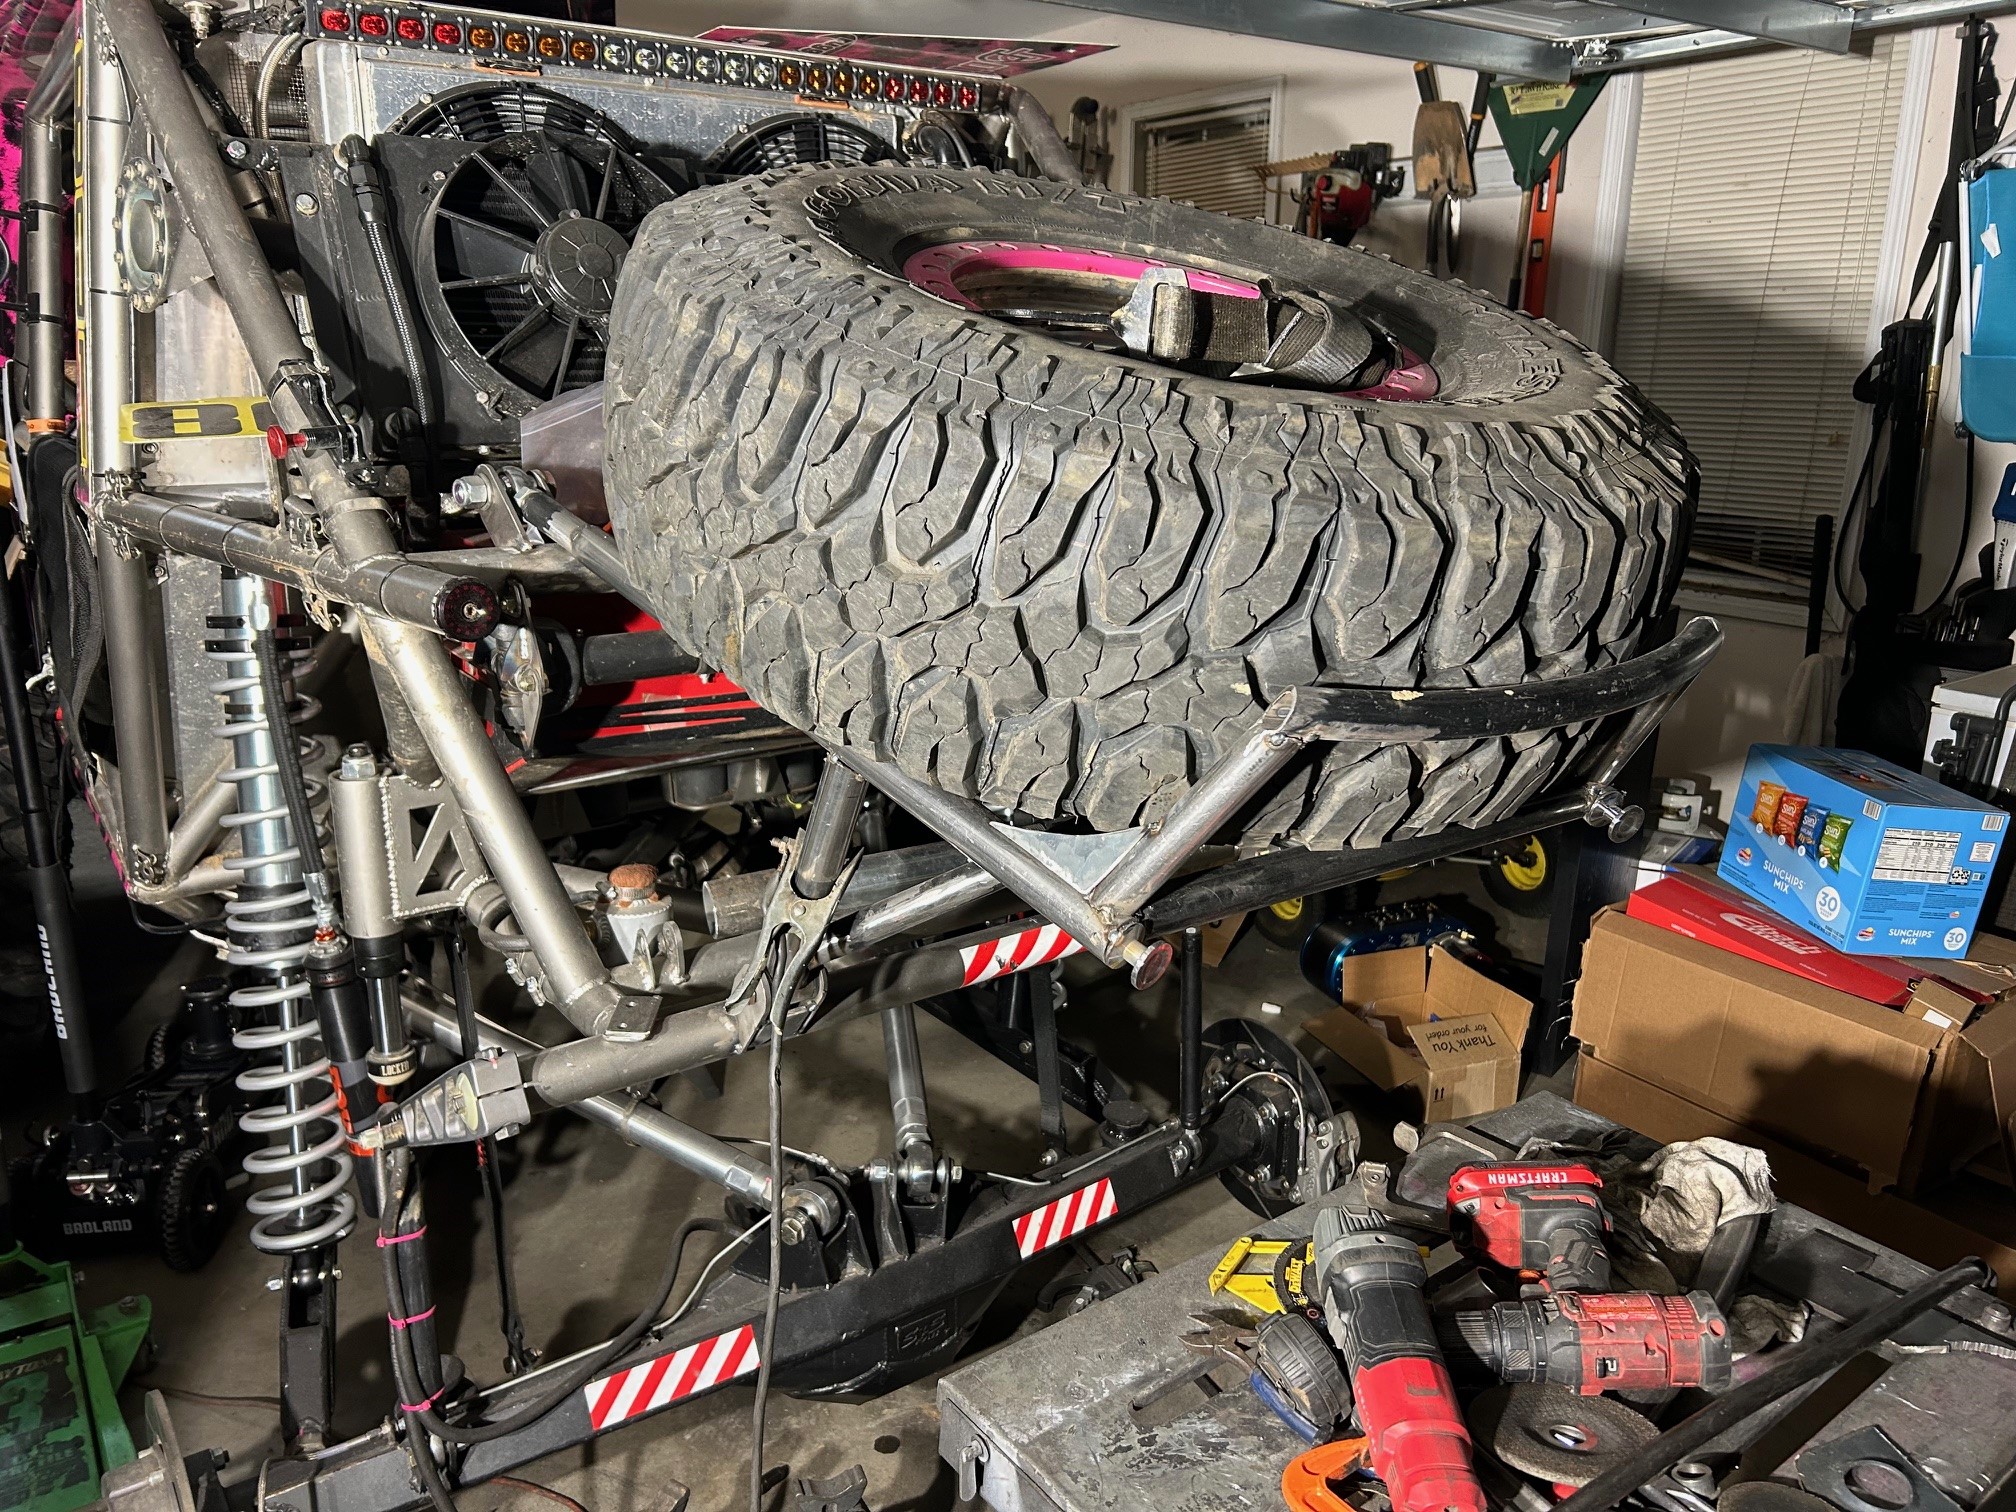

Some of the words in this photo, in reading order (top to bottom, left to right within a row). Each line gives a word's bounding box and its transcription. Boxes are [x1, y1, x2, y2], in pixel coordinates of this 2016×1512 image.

[1763, 859, 1805, 890] SUNCHIPS
[1773, 878, 1791, 895] MIX
[1818, 891, 1838, 912] 30
[1888, 928, 1932, 939] SUNCHIPS
[1946, 932, 1964, 943] 30
[1900, 937, 1918, 946] MIX
[1452, 1024, 1471, 1035] your
[1474, 1023, 1488, 1032] for
[1425, 1029, 1450, 1042] order!
[1432, 1041, 1459, 1054] You
[1459, 1034, 1496, 1051] Thank
[1487, 1171, 1569, 1185] CRAFTSMAN
[63, 1218, 133, 1235] BADLAND
